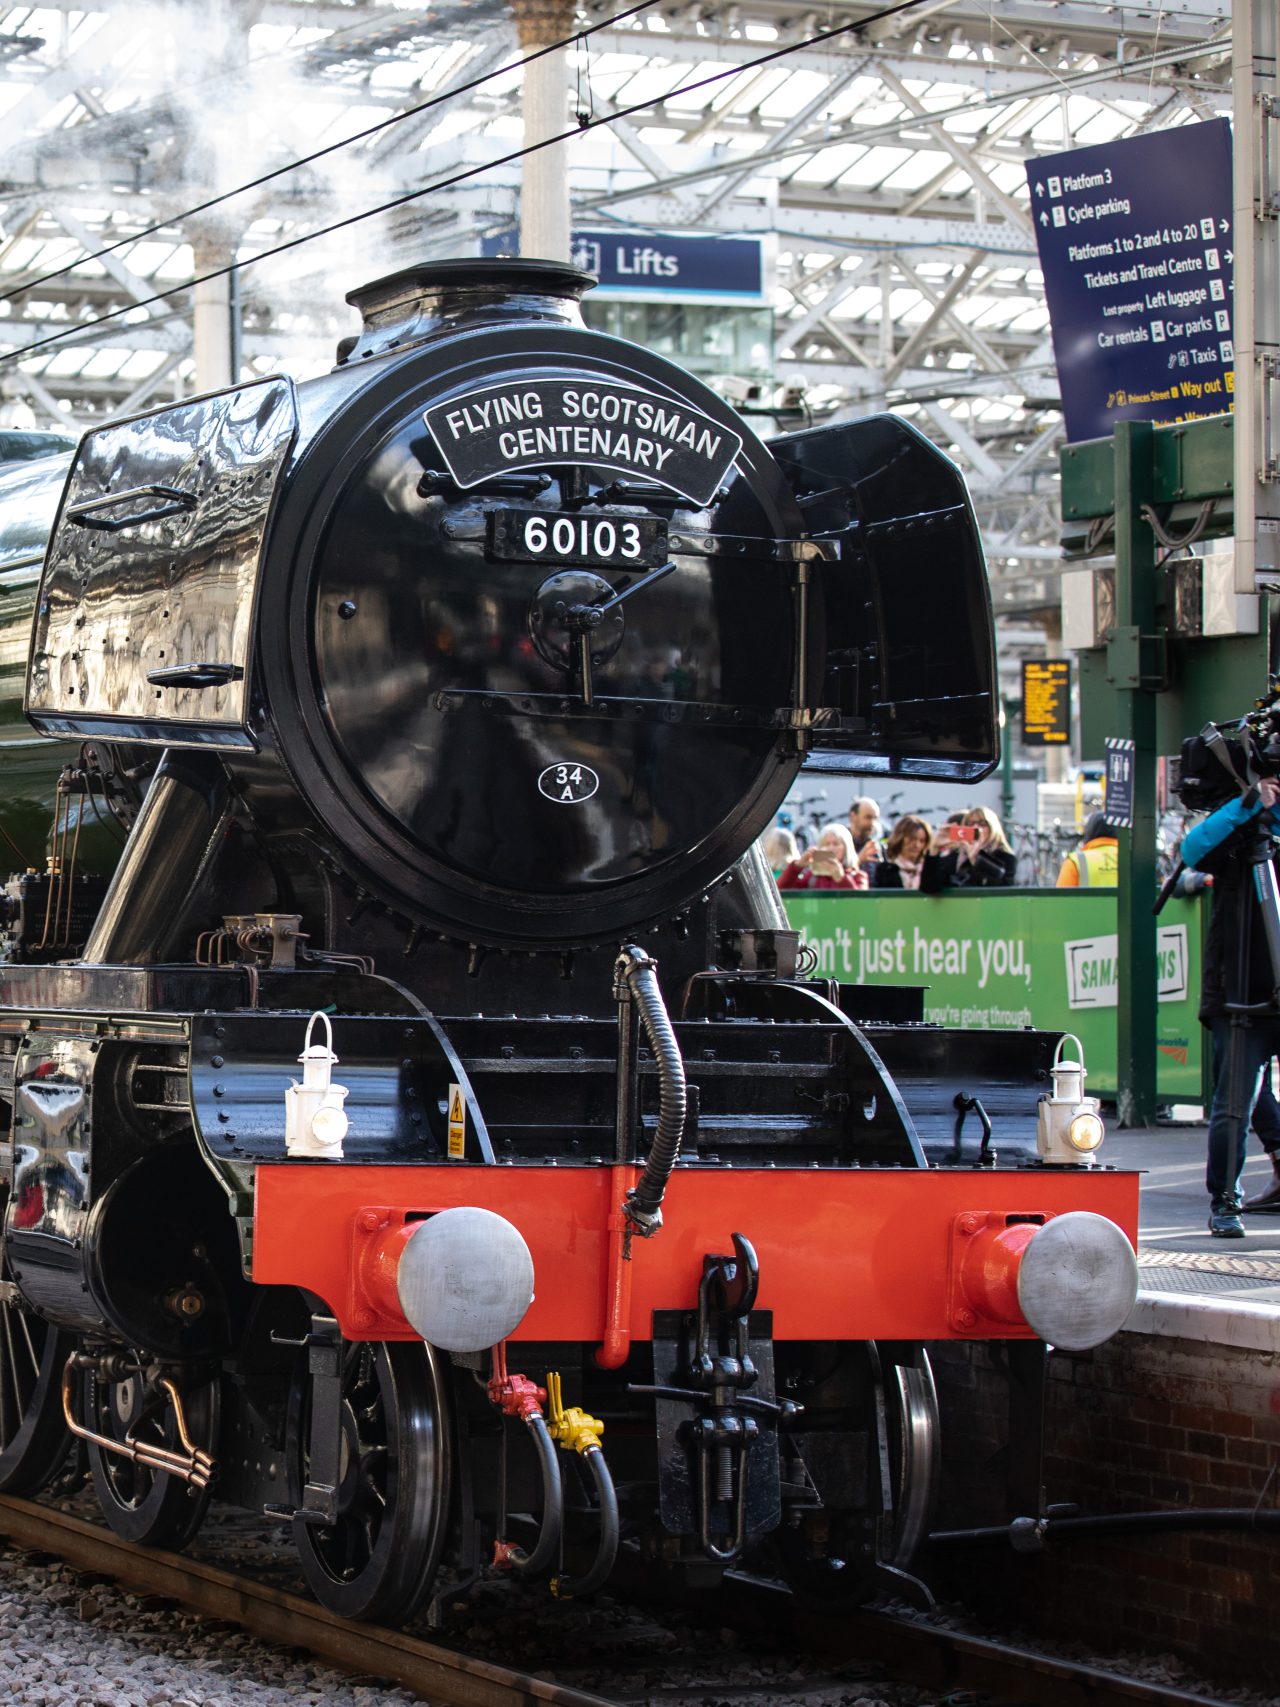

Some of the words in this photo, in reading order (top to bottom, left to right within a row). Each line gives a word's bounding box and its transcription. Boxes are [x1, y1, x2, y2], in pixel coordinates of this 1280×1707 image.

[1063, 172, 1104, 192] Platform
[1105, 168, 1113, 184] 3
[1068, 203, 1094, 223] Cycle
[1095, 199, 1131, 219] parking
[1068, 241, 1113, 262] Platforms
[1115, 238, 1121, 253] 1
[1123, 236, 1134, 252] to
[1134, 234, 1143, 249] 2
[1143, 230, 1161, 248] and
[1162, 228, 1170, 244] 4
[1171, 227, 1182, 243] to
[1183, 224, 1198, 240] 20
[616, 246, 679, 277] Lifts
[1084, 271, 1118, 289] Tickets
[1119, 265, 1137, 283] and
[1138, 260, 1167, 280] Travel
[1169, 257, 1202, 276] Centre
[1145, 290, 1166, 309] Left
[1167, 288, 1207, 307] luggage
[1097, 331, 1114, 348] Car
[1115, 326, 1148, 346] rentals
[1166, 321, 1184, 338] Car
[1185, 316, 1213, 338] parks
[1190, 348, 1217, 365] Taxis
[1180, 381, 1202, 399] Way
[1204, 379, 1222, 394] out
[445, 392, 543, 440] FLYING
[562, 390, 721, 461] SCOTSMAN
[498, 426, 674, 471] CENTENARY
[524, 517, 641, 558] 60103
[556, 766, 582, 785] 34
[560, 785, 573, 800] A
[856, 926, 906, 985] just
[914, 926, 972, 975] hear
[978, 939, 1032, 988] you,
[961, 1005, 989, 1029] going
[990, 1006, 1032, 1030] through
